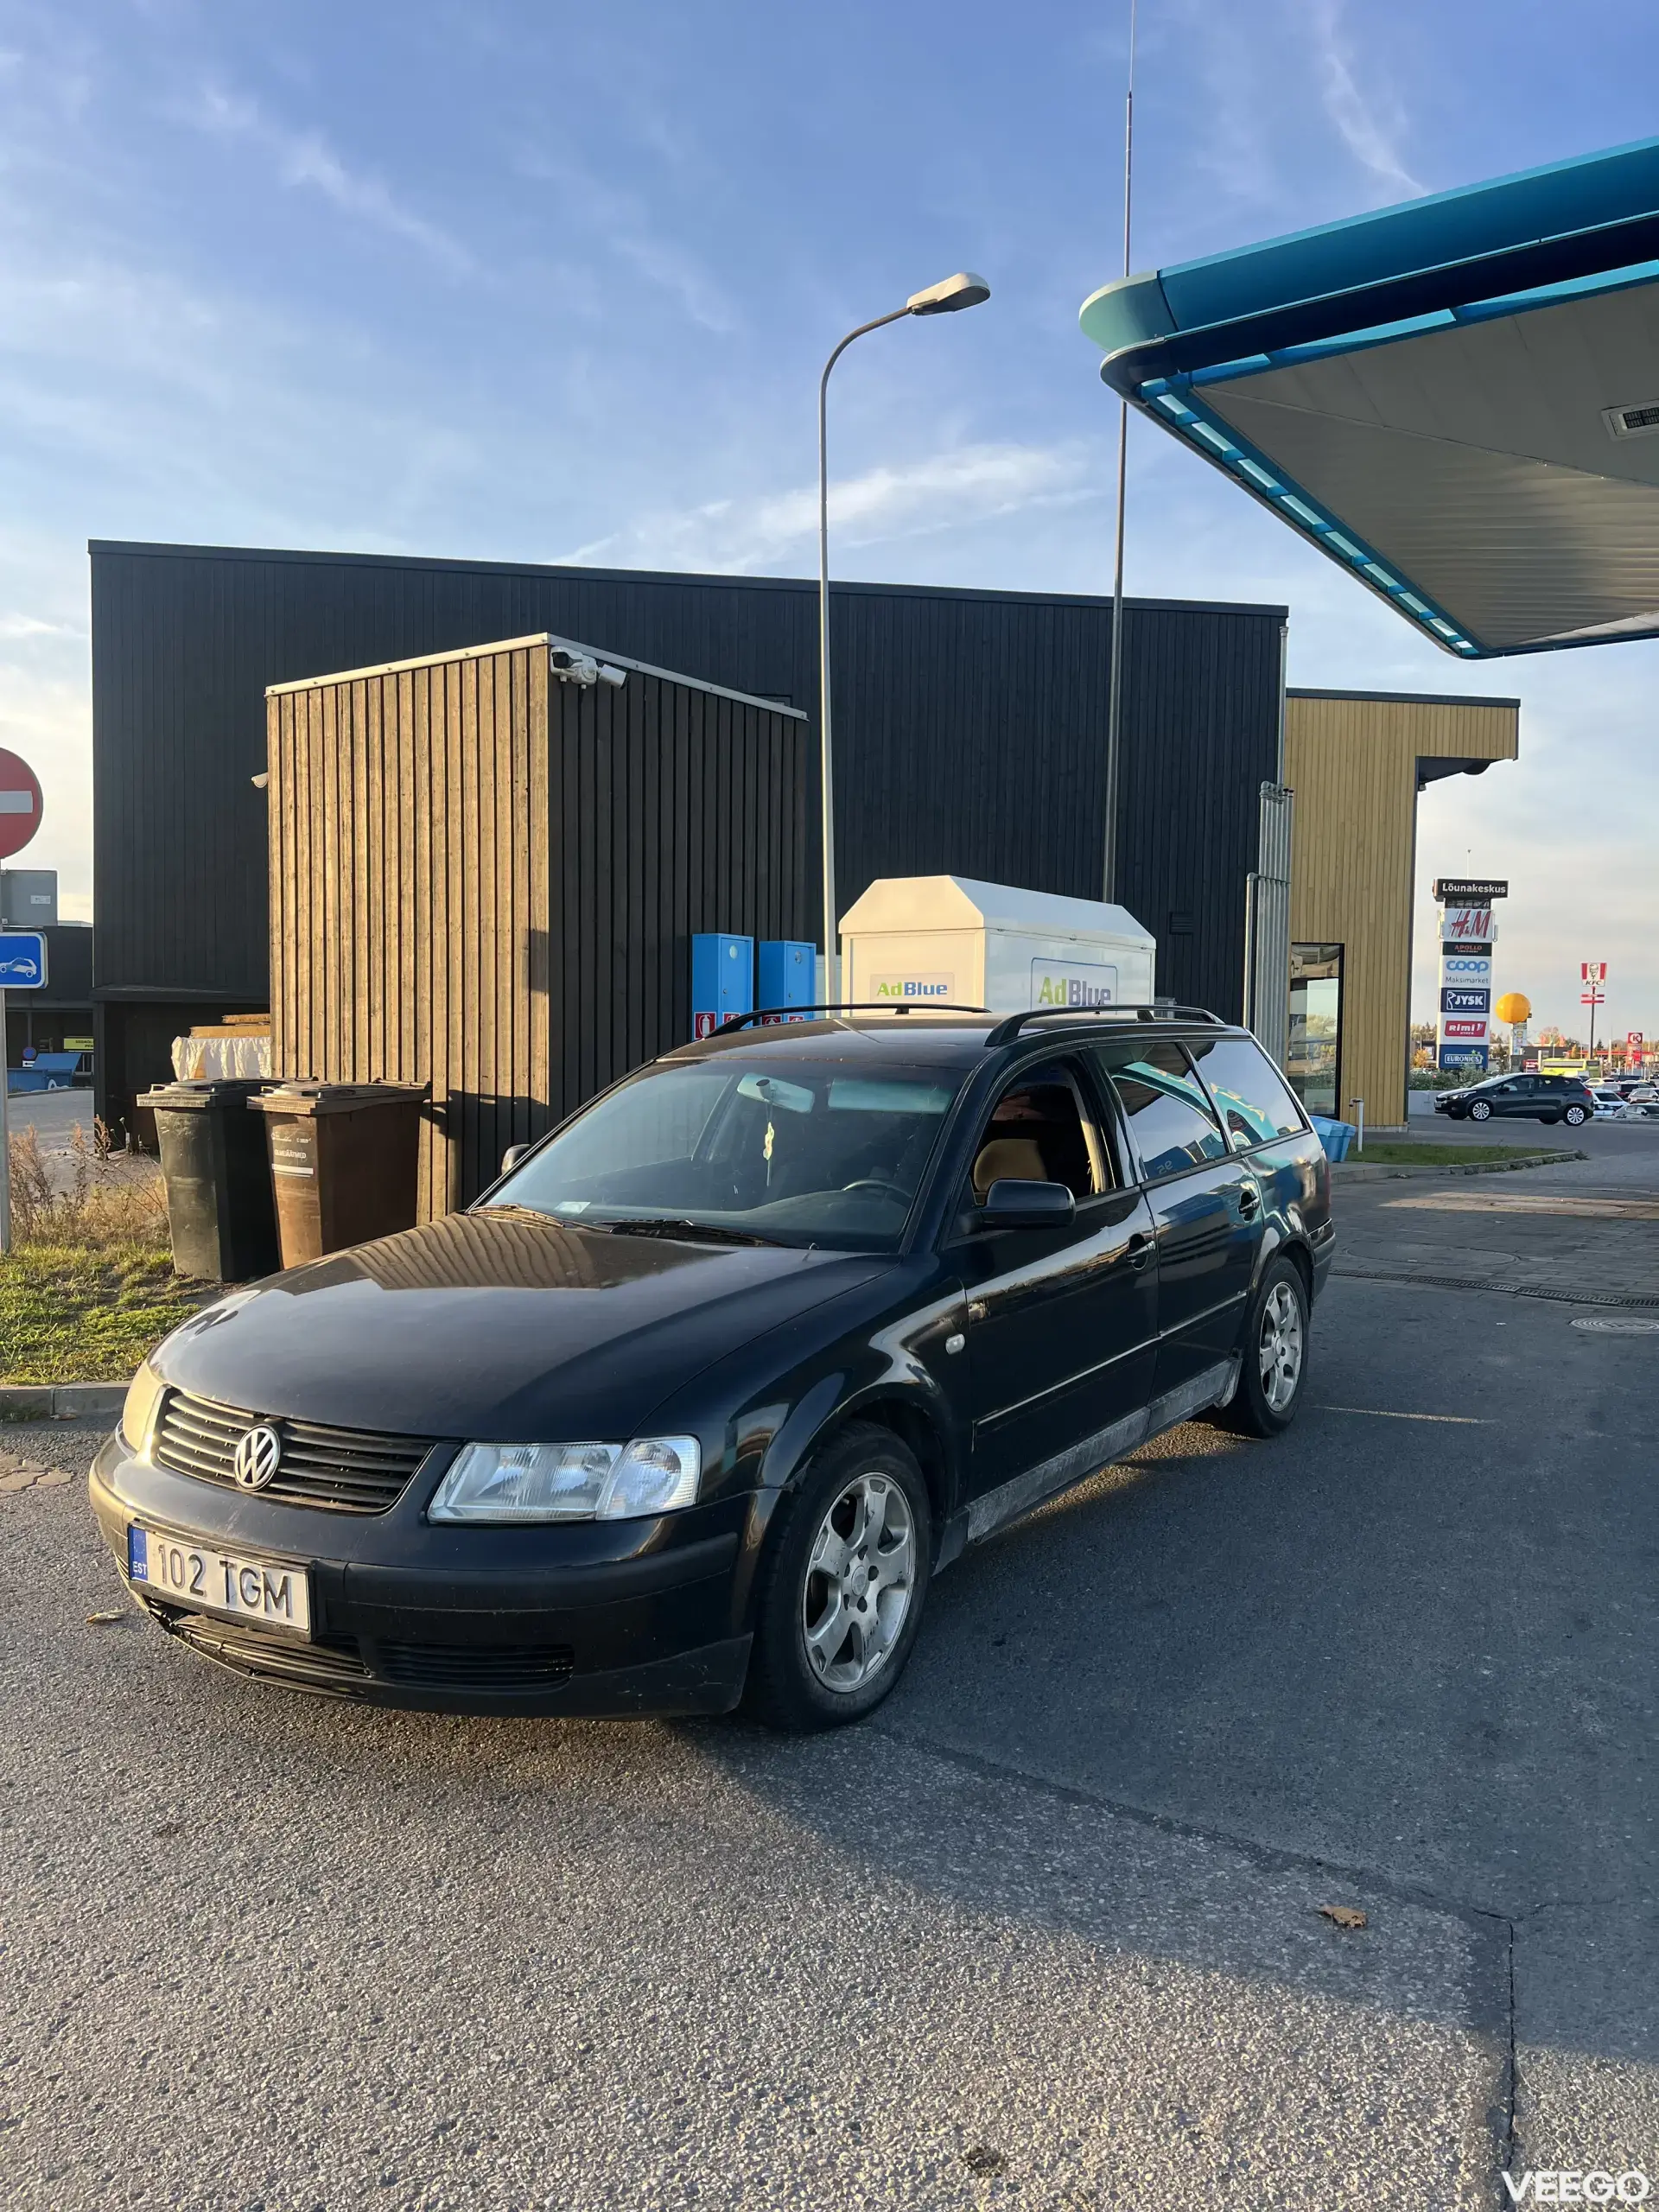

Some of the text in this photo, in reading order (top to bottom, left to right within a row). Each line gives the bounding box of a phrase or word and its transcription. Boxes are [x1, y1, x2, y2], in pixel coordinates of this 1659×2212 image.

[1442, 883, 1506, 893] Lõunakeskus
[1451, 910, 1491, 938] H&M
[1446, 961, 1489, 973] coop
[876, 982, 948, 996] AdBlue
[1039, 976, 1111, 1006] AdBlue
[1454, 995, 1484, 1006] JYSK
[133, 1560, 148, 1576] EST
[158, 1543, 294, 1619] 102 TGM
